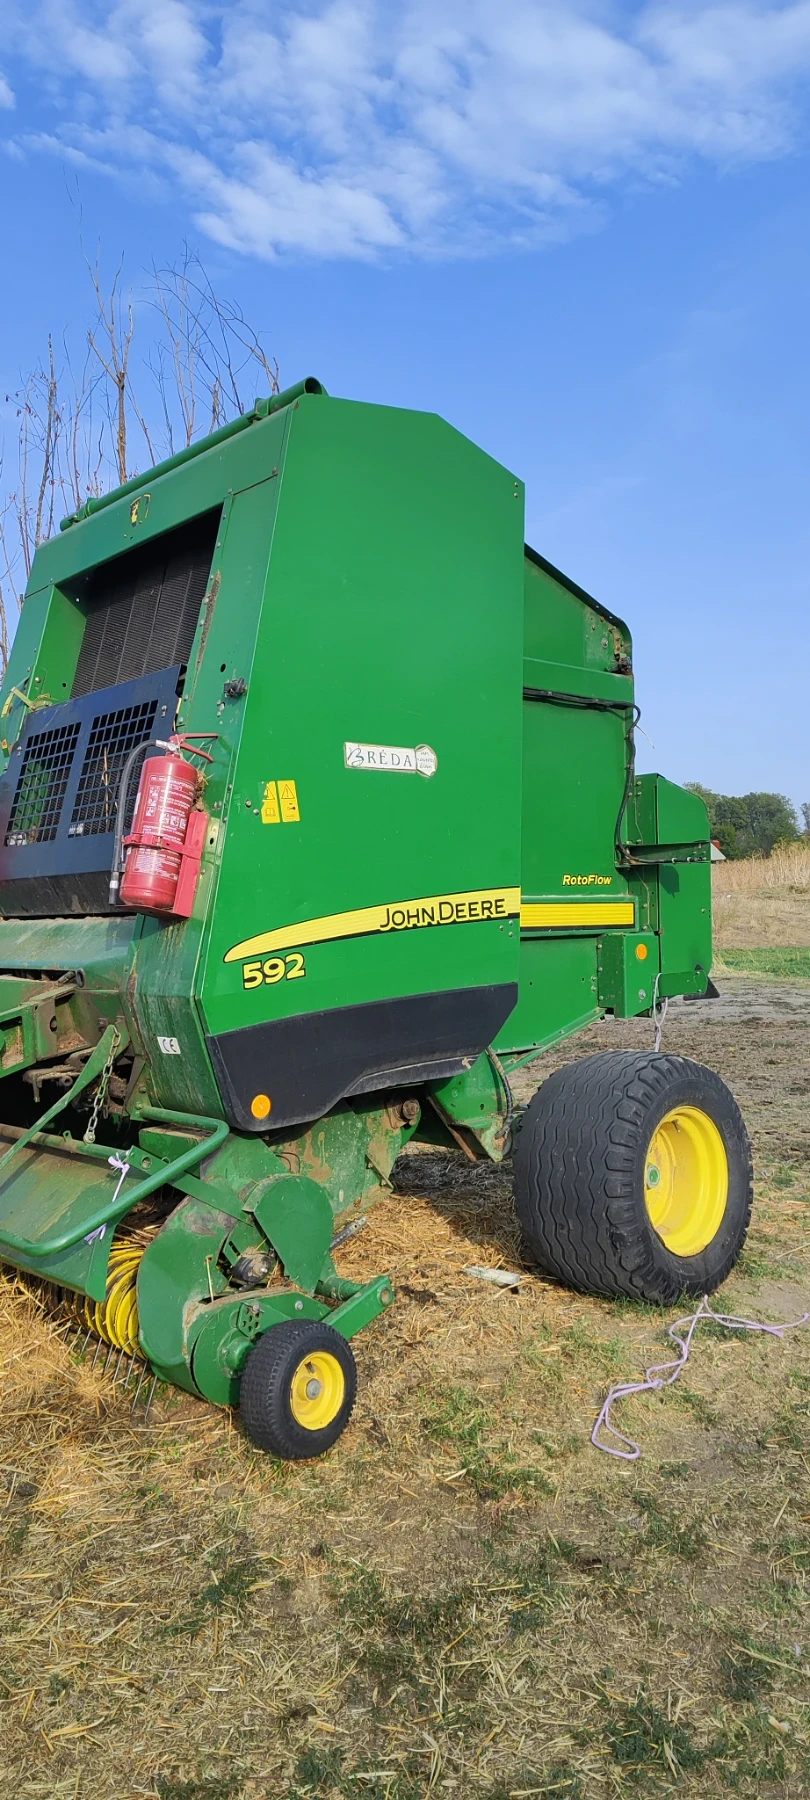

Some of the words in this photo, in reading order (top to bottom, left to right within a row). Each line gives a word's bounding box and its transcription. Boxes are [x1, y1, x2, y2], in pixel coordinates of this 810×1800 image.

[562, 874, 612, 886] RotoFlow
[380, 907, 435, 928] JOHN
[438, 898, 506, 921] DEERE
[242, 952, 306, 990] 592
